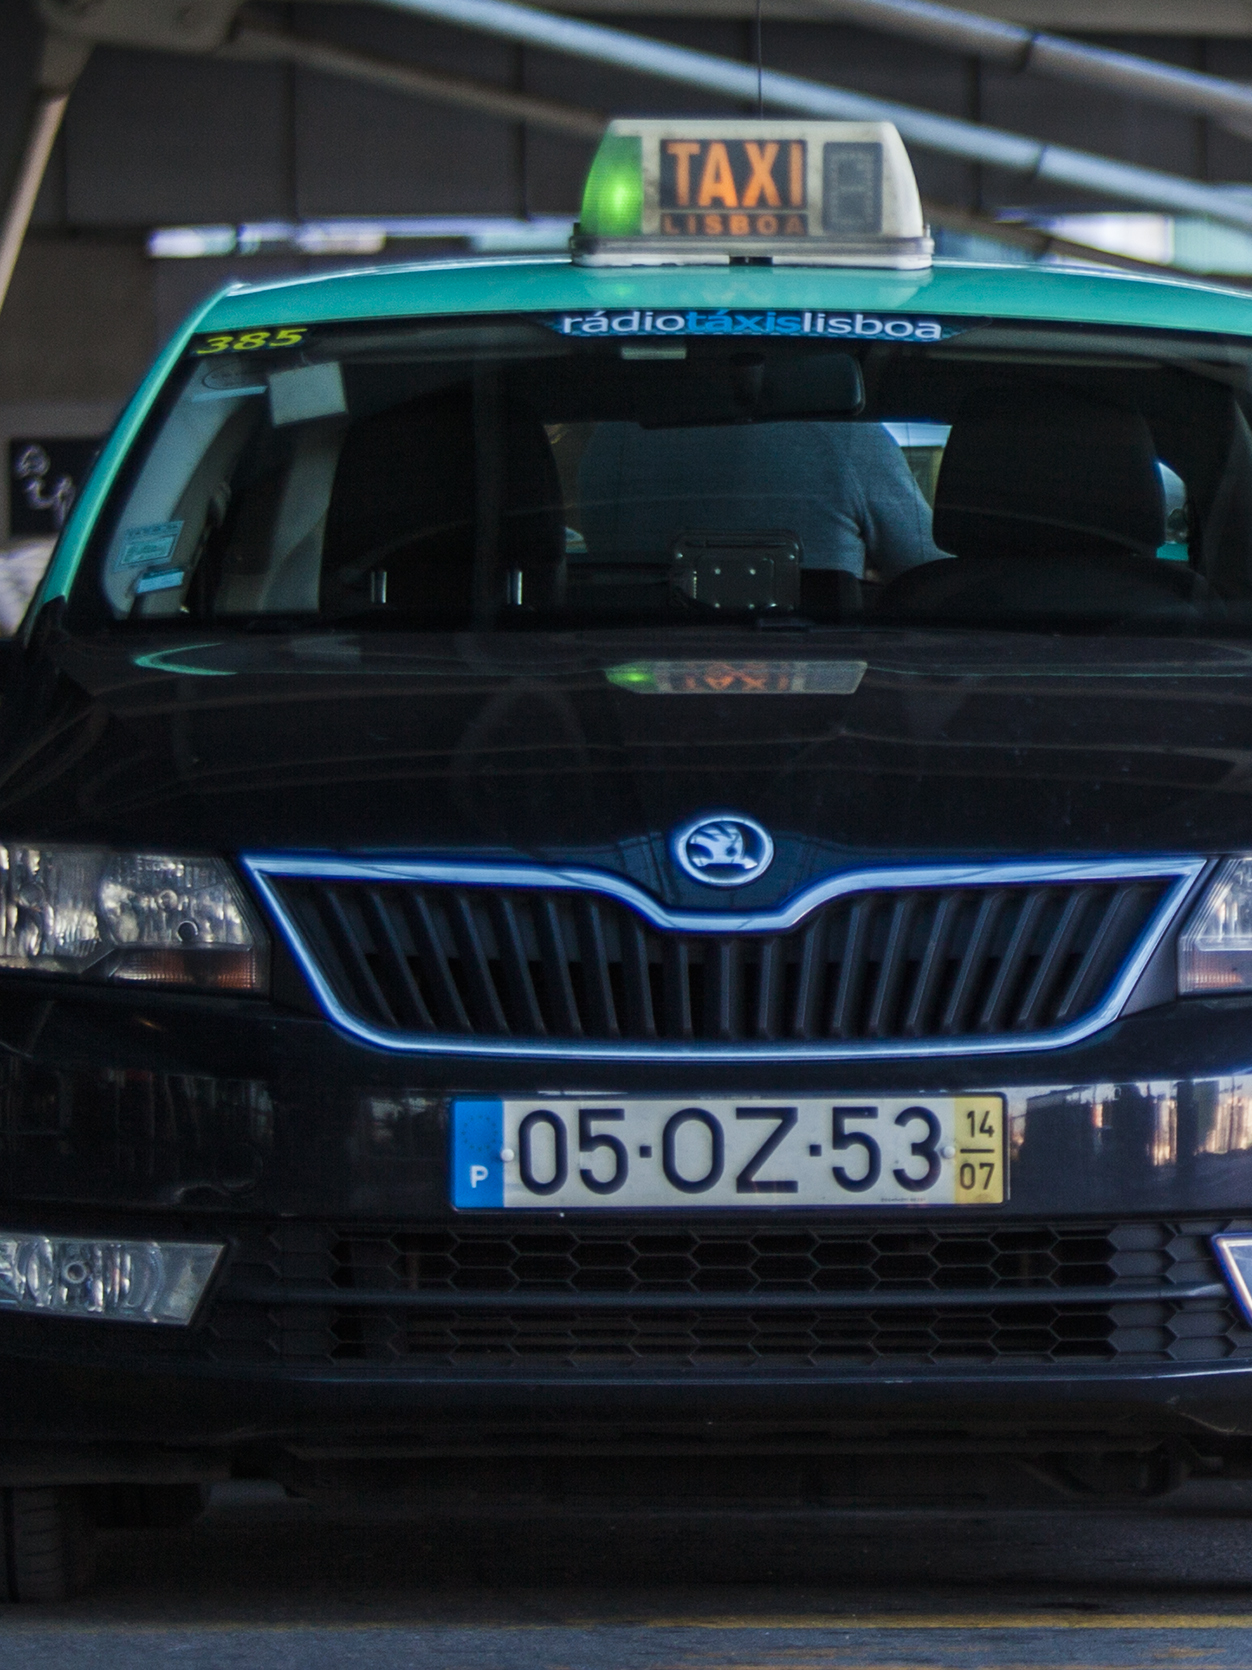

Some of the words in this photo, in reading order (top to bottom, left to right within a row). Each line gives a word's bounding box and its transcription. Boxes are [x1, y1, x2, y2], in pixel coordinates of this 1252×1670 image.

[666, 142, 804, 208] TAXI
[664, 214, 805, 236] LISBOA
[563, 309, 942, 340] rádiotáxislisboa
[196, 329, 308, 355] 385
[967, 1110, 995, 1138] 14
[470, 1165, 489, 1188] P
[959, 1162, 995, 1190] 07
